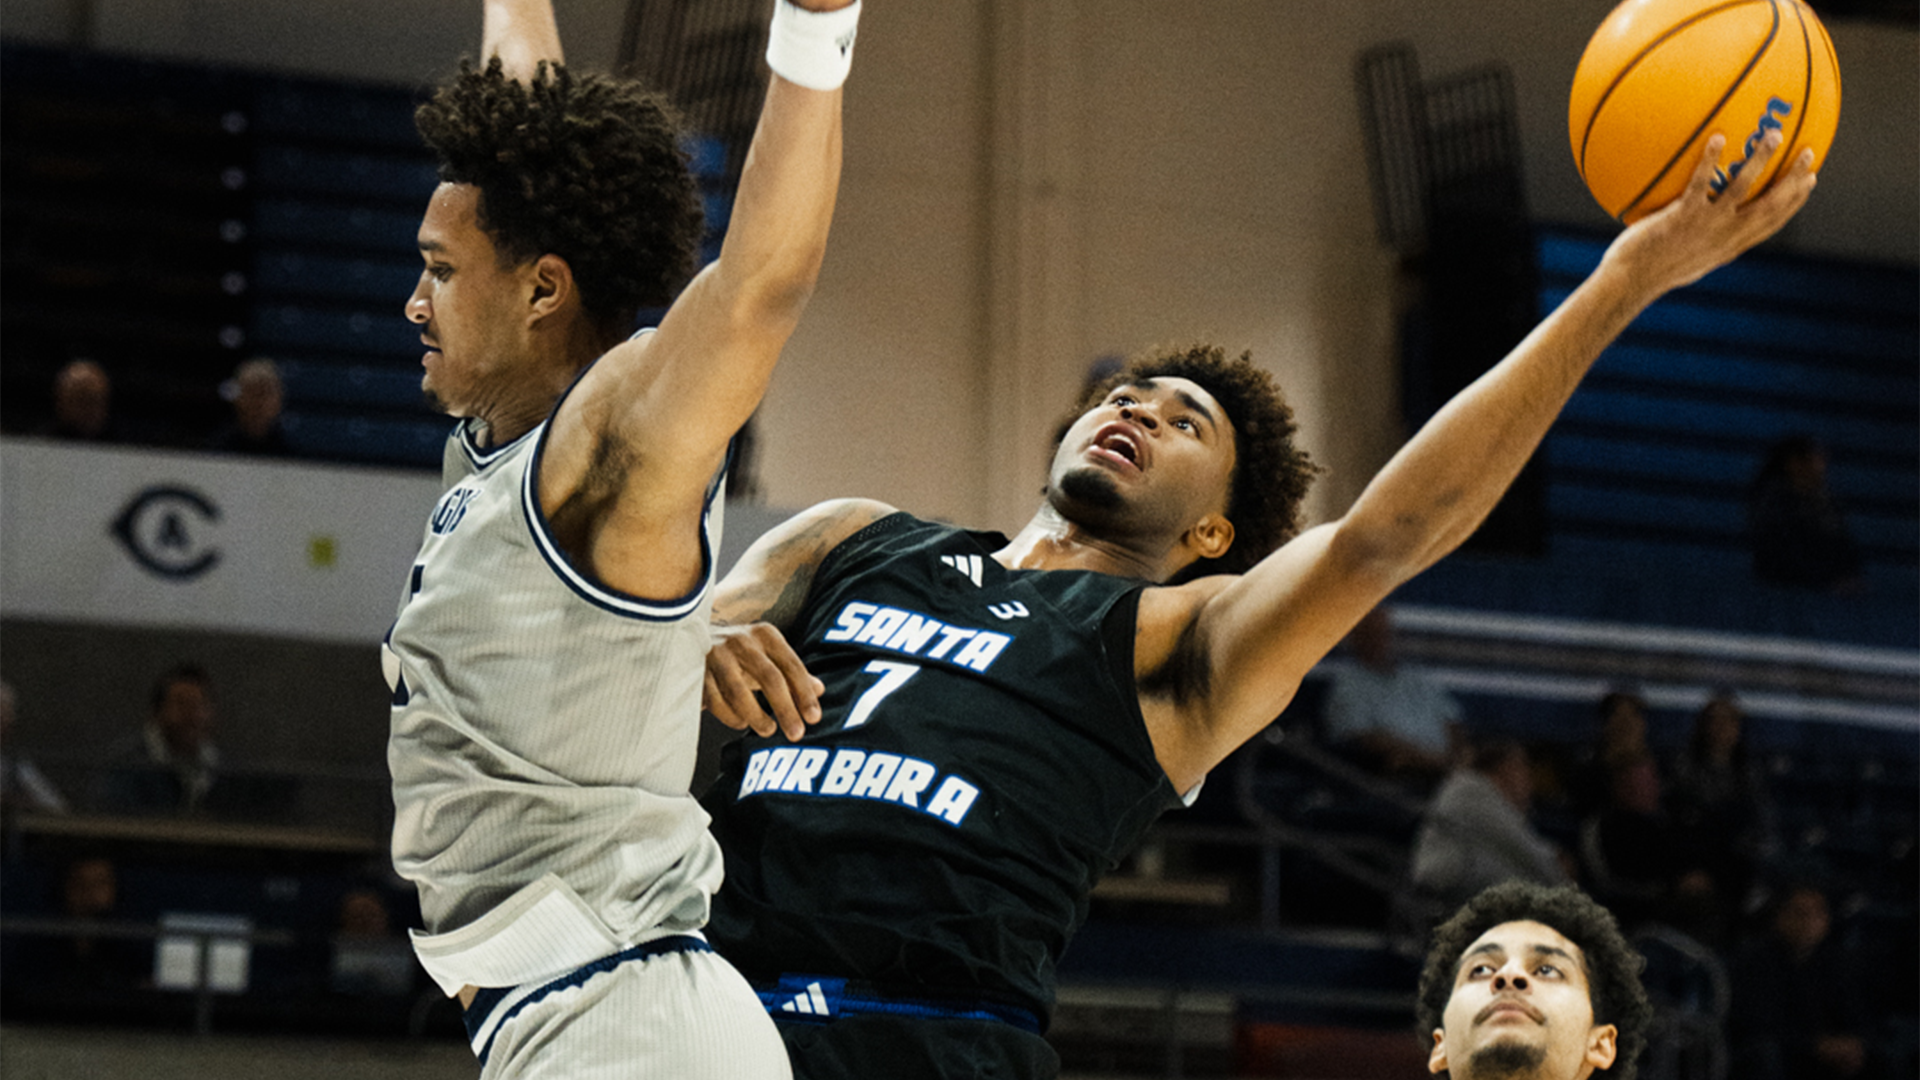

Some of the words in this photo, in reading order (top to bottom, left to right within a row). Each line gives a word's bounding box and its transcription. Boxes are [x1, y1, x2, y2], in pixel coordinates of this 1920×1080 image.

[823, 601, 1015, 673] SANTA
[843, 659, 921, 729] 7
[737, 746, 981, 826] BARBARA
